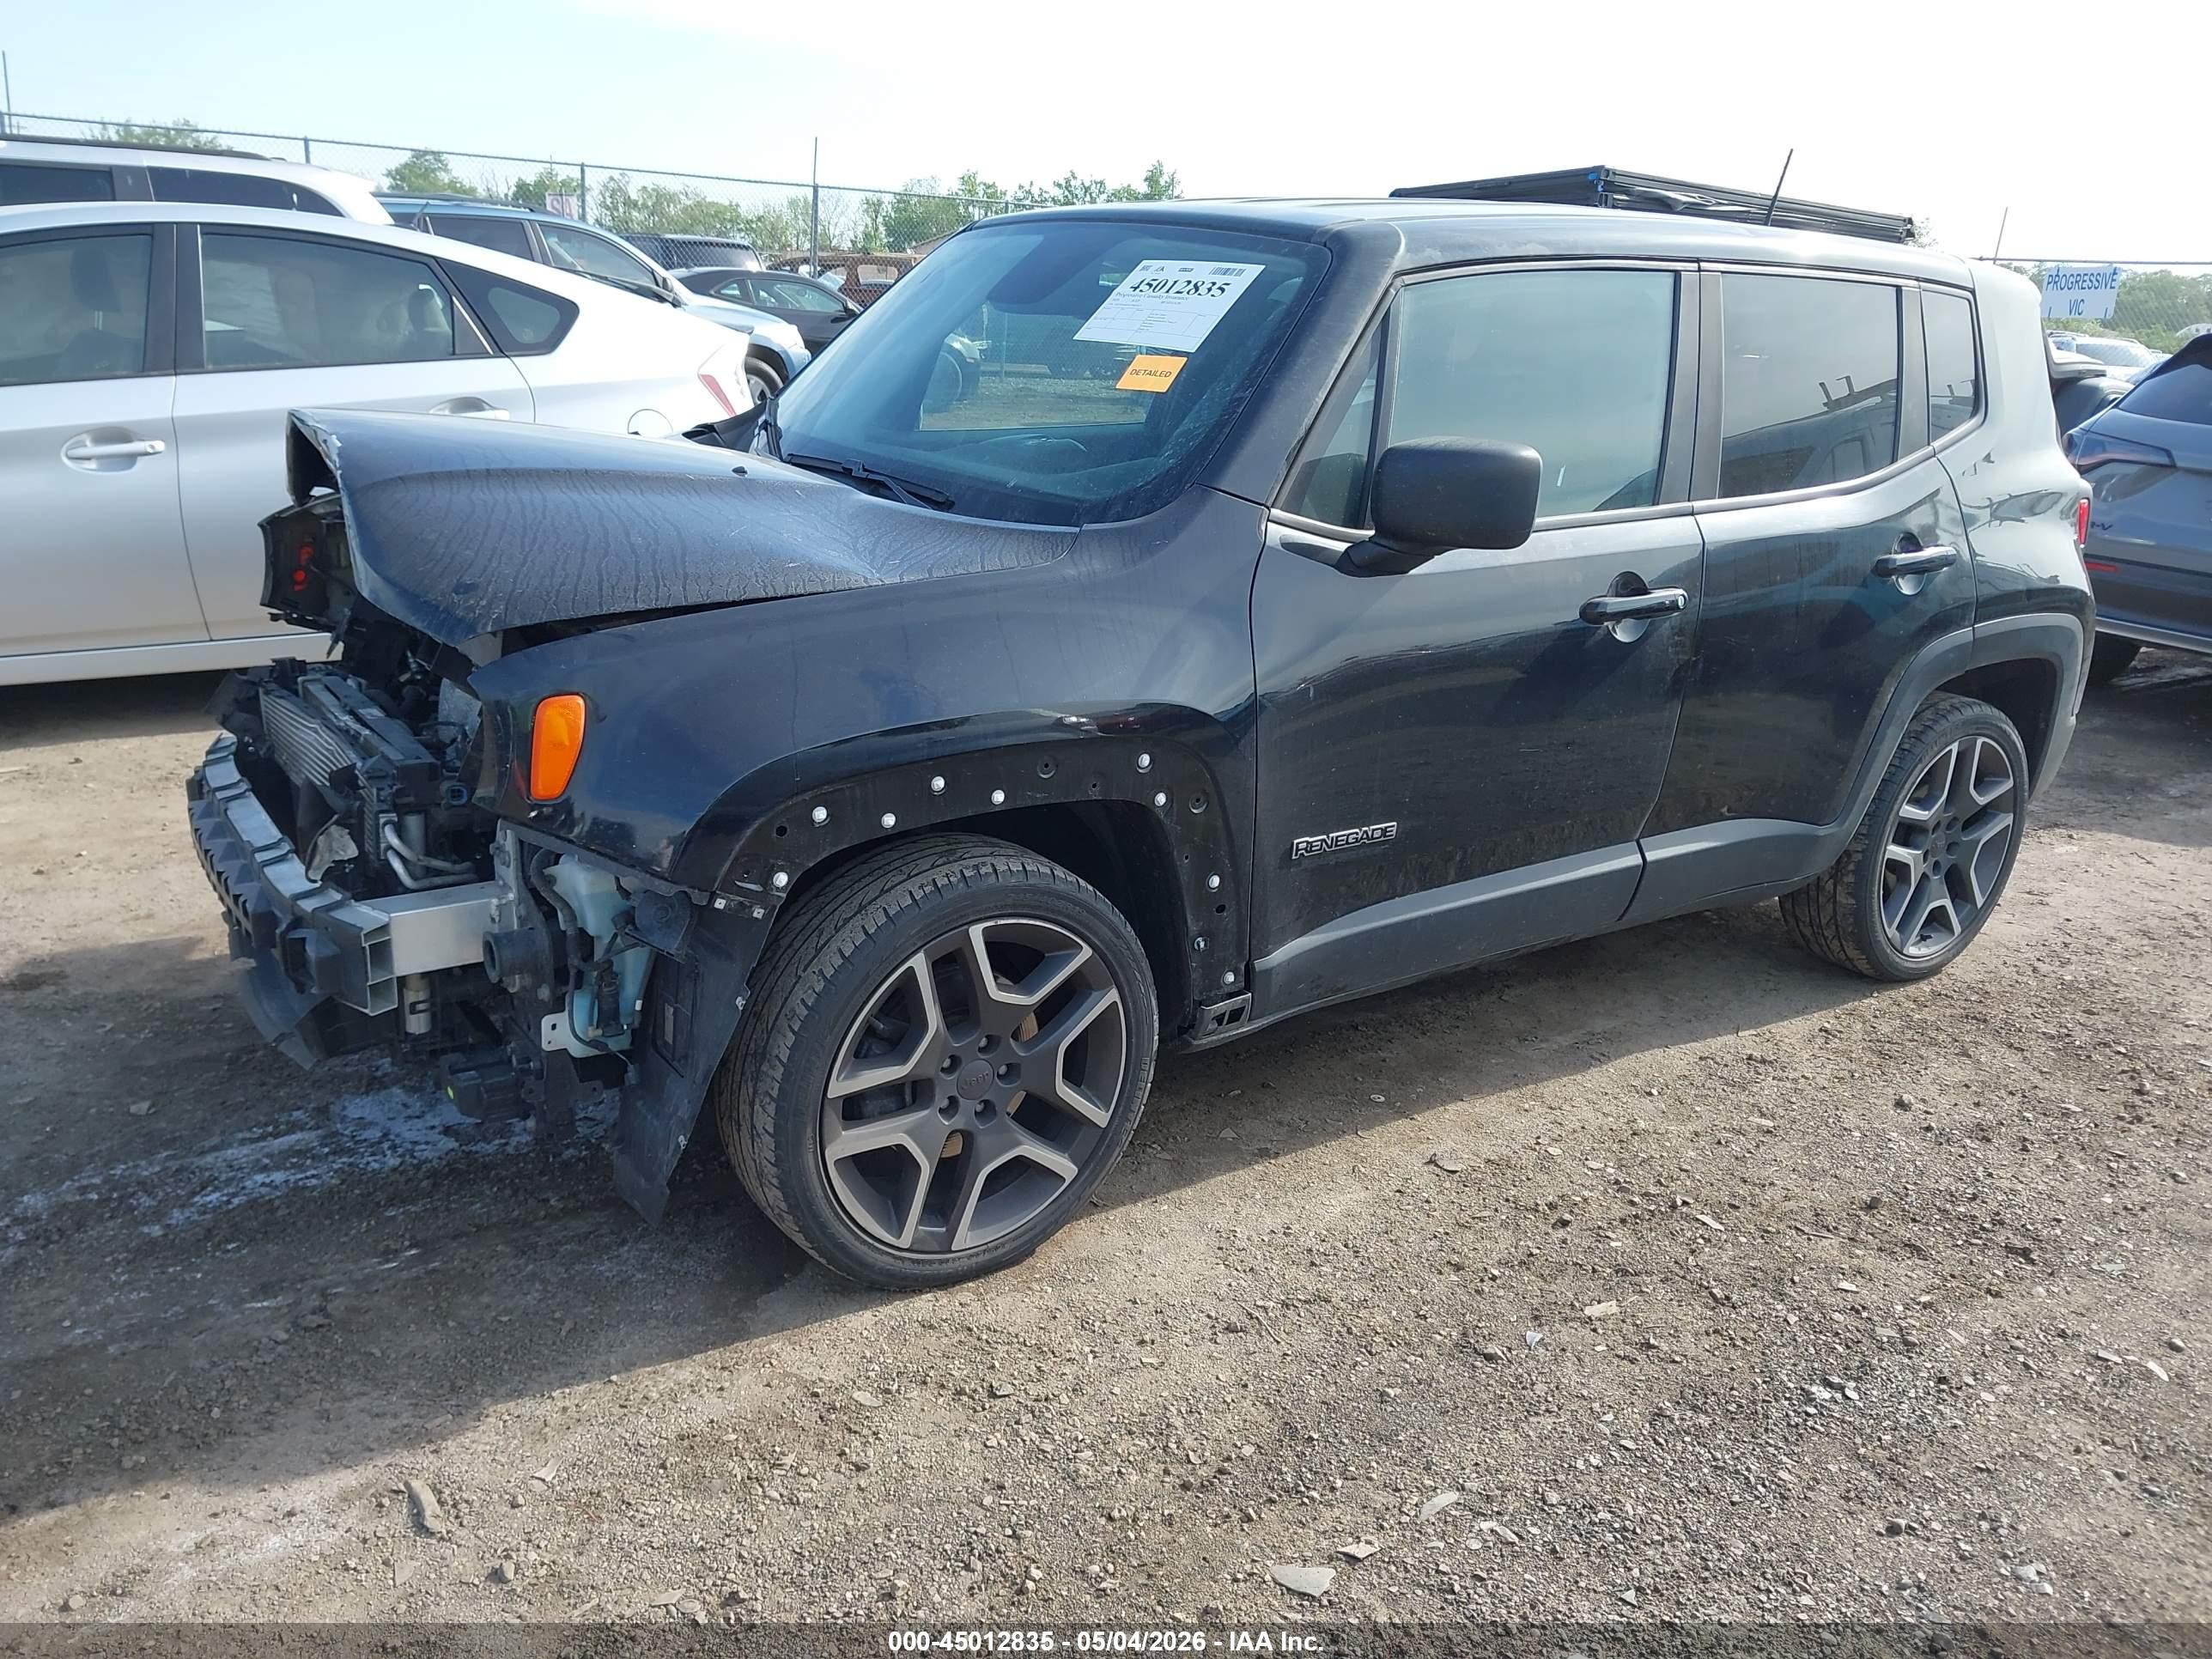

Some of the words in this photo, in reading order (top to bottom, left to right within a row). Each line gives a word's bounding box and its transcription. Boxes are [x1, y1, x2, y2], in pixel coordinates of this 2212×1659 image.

[1129, 277, 1231, 297] 45012835
[2045, 272, 2118, 291] PROGRESSIVE
[2069, 299, 2086, 316] VIC
[1130, 368, 1172, 378] DETAILED
[1291, 822, 1397, 859] RENEGADE
